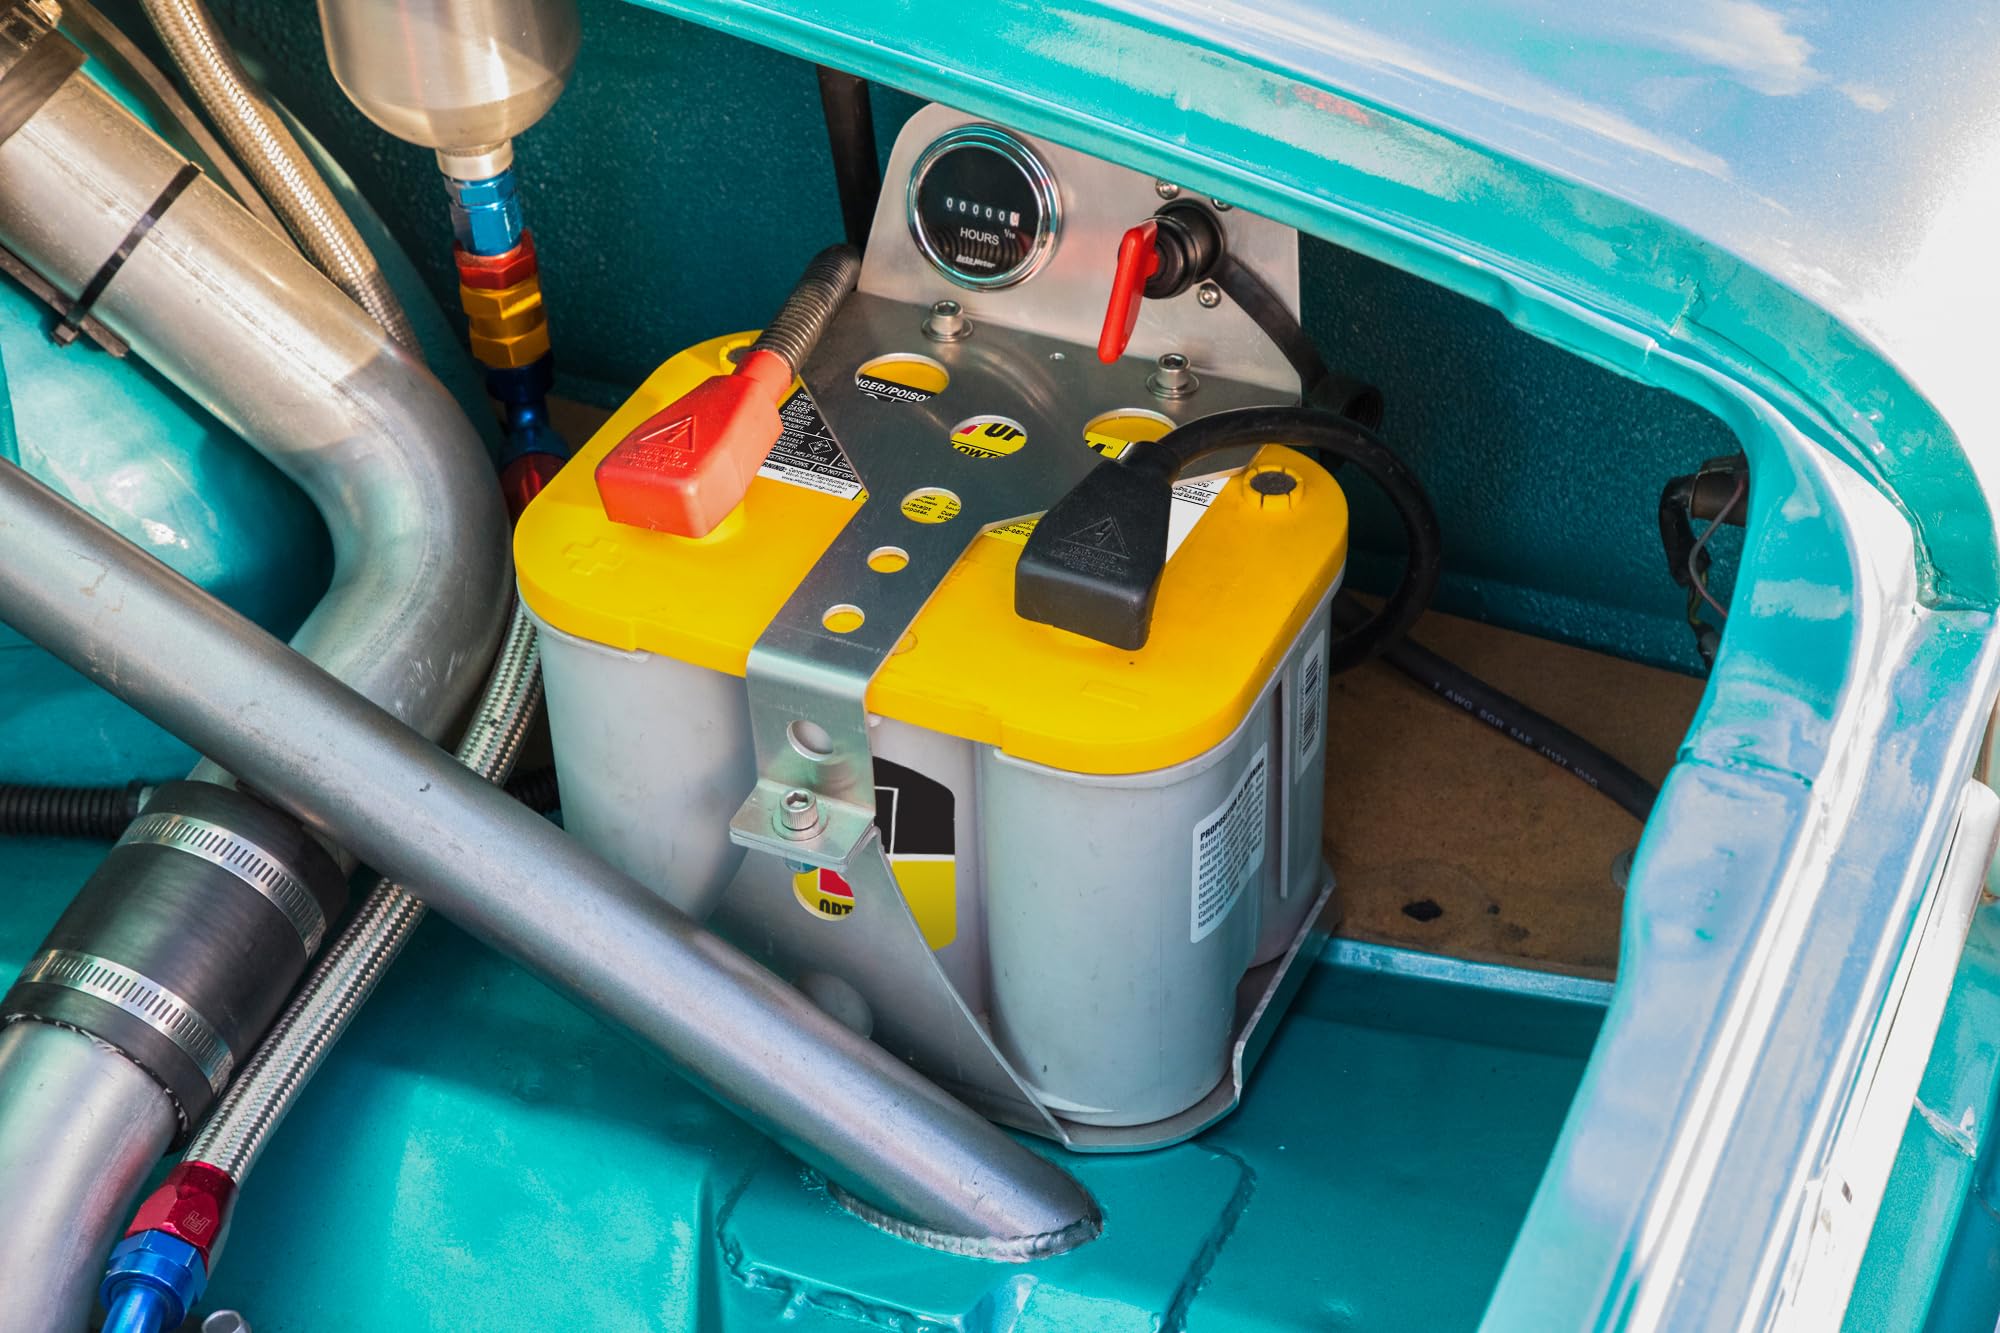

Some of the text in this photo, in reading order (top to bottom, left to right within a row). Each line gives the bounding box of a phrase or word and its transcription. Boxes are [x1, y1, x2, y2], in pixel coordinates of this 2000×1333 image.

[960, 227, 1000, 246] HOURS
[1200, 798, 1236, 843] PROPOSITION
[1199, 828, 1221, 853] Battery
